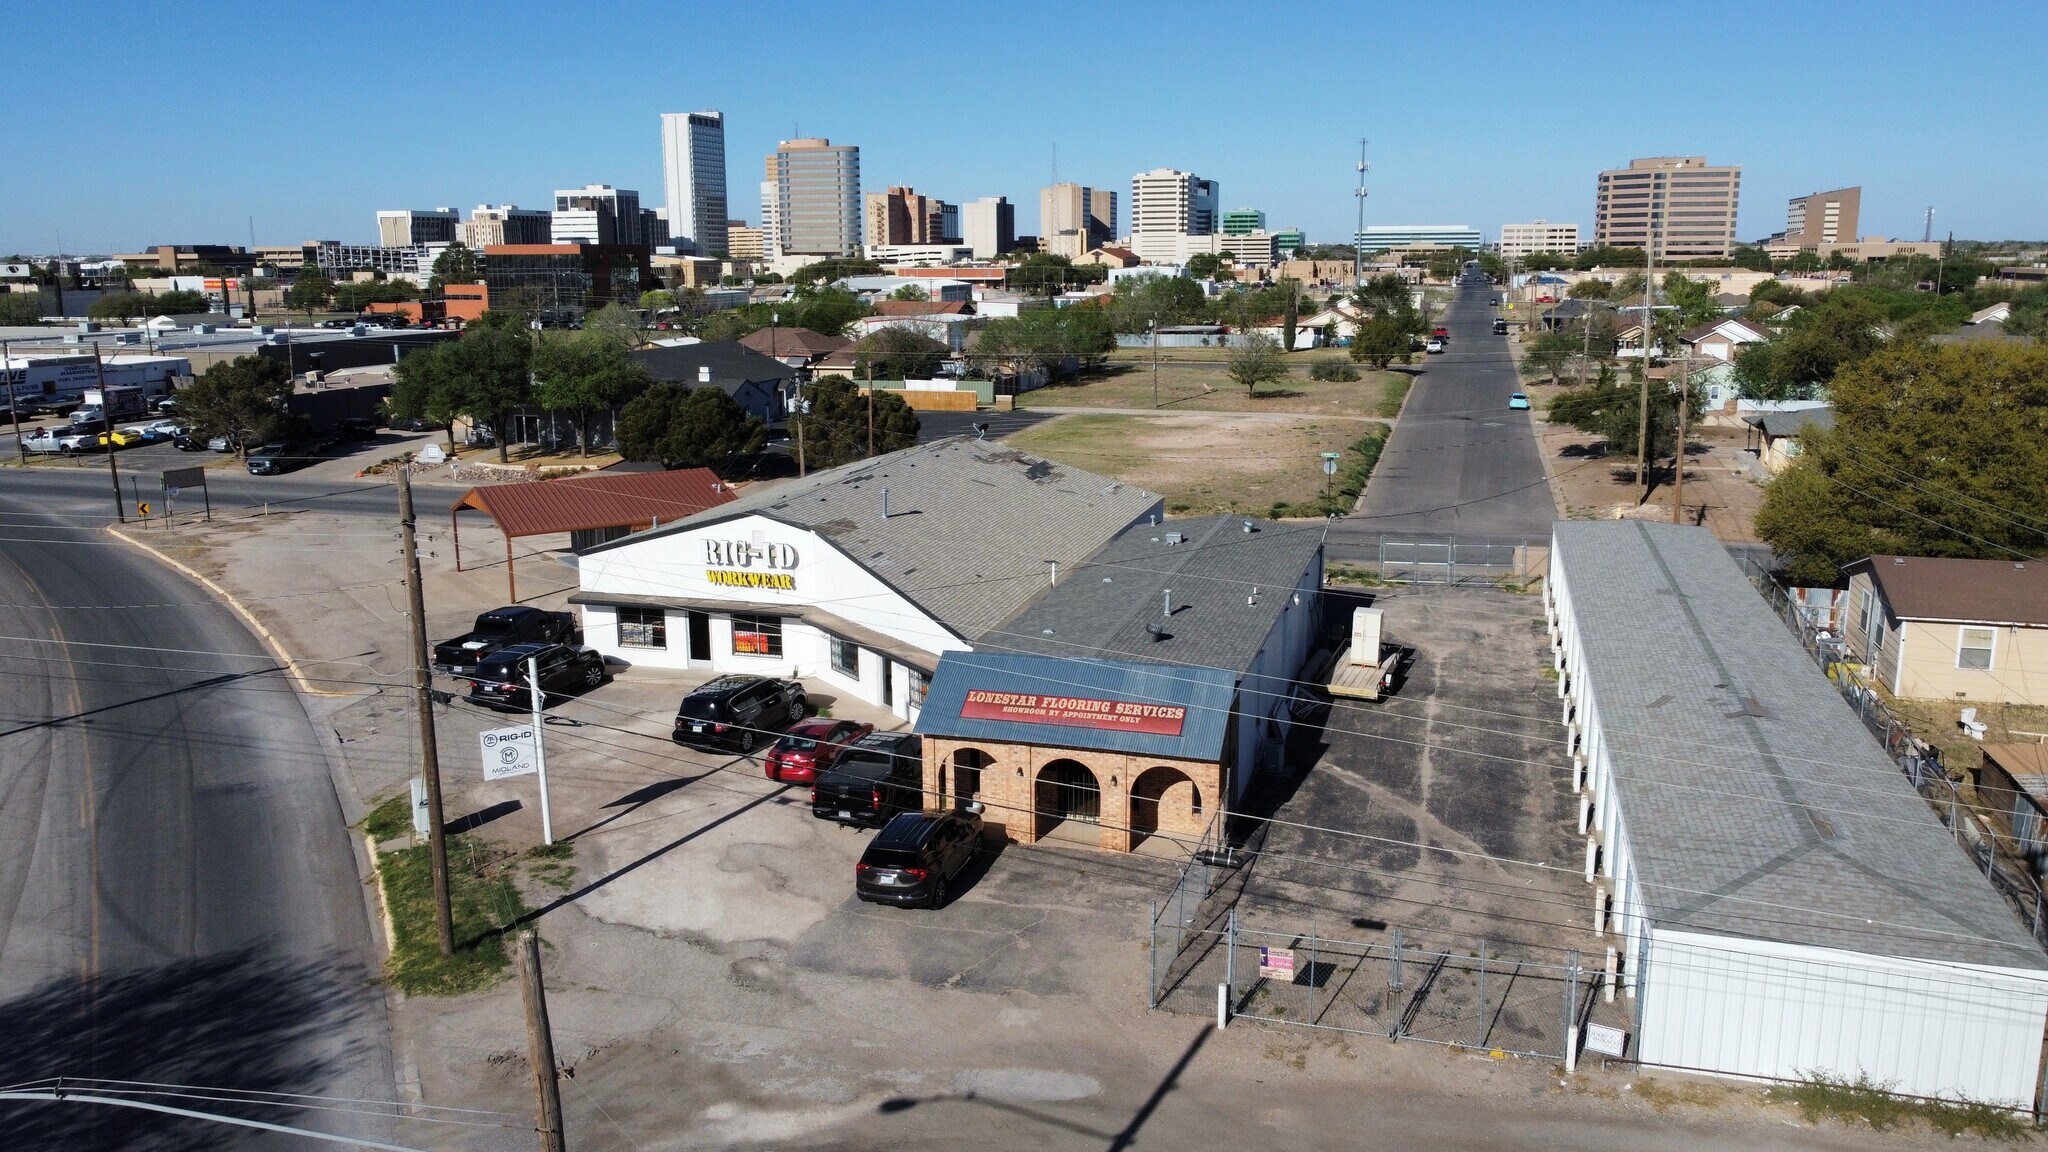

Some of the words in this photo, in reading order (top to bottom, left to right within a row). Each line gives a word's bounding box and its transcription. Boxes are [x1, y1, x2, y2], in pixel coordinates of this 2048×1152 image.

[701, 539, 799, 570] RIG-ID
[706, 570, 796, 590] WORKWEAR
[968, 690, 1037, 707] LONESTAR
[1041, 697, 1111, 713] FLOORING
[1115, 703, 1185, 719] SERVICES
[1002, 706, 1046, 716] SHOWROOM
[1062, 711, 1118, 722] APPOINTMENT
[1119, 715, 1141, 724] ONLY
[499, 731, 532, 742] RIG-ID
[492, 763, 530, 774] MIDLAND
